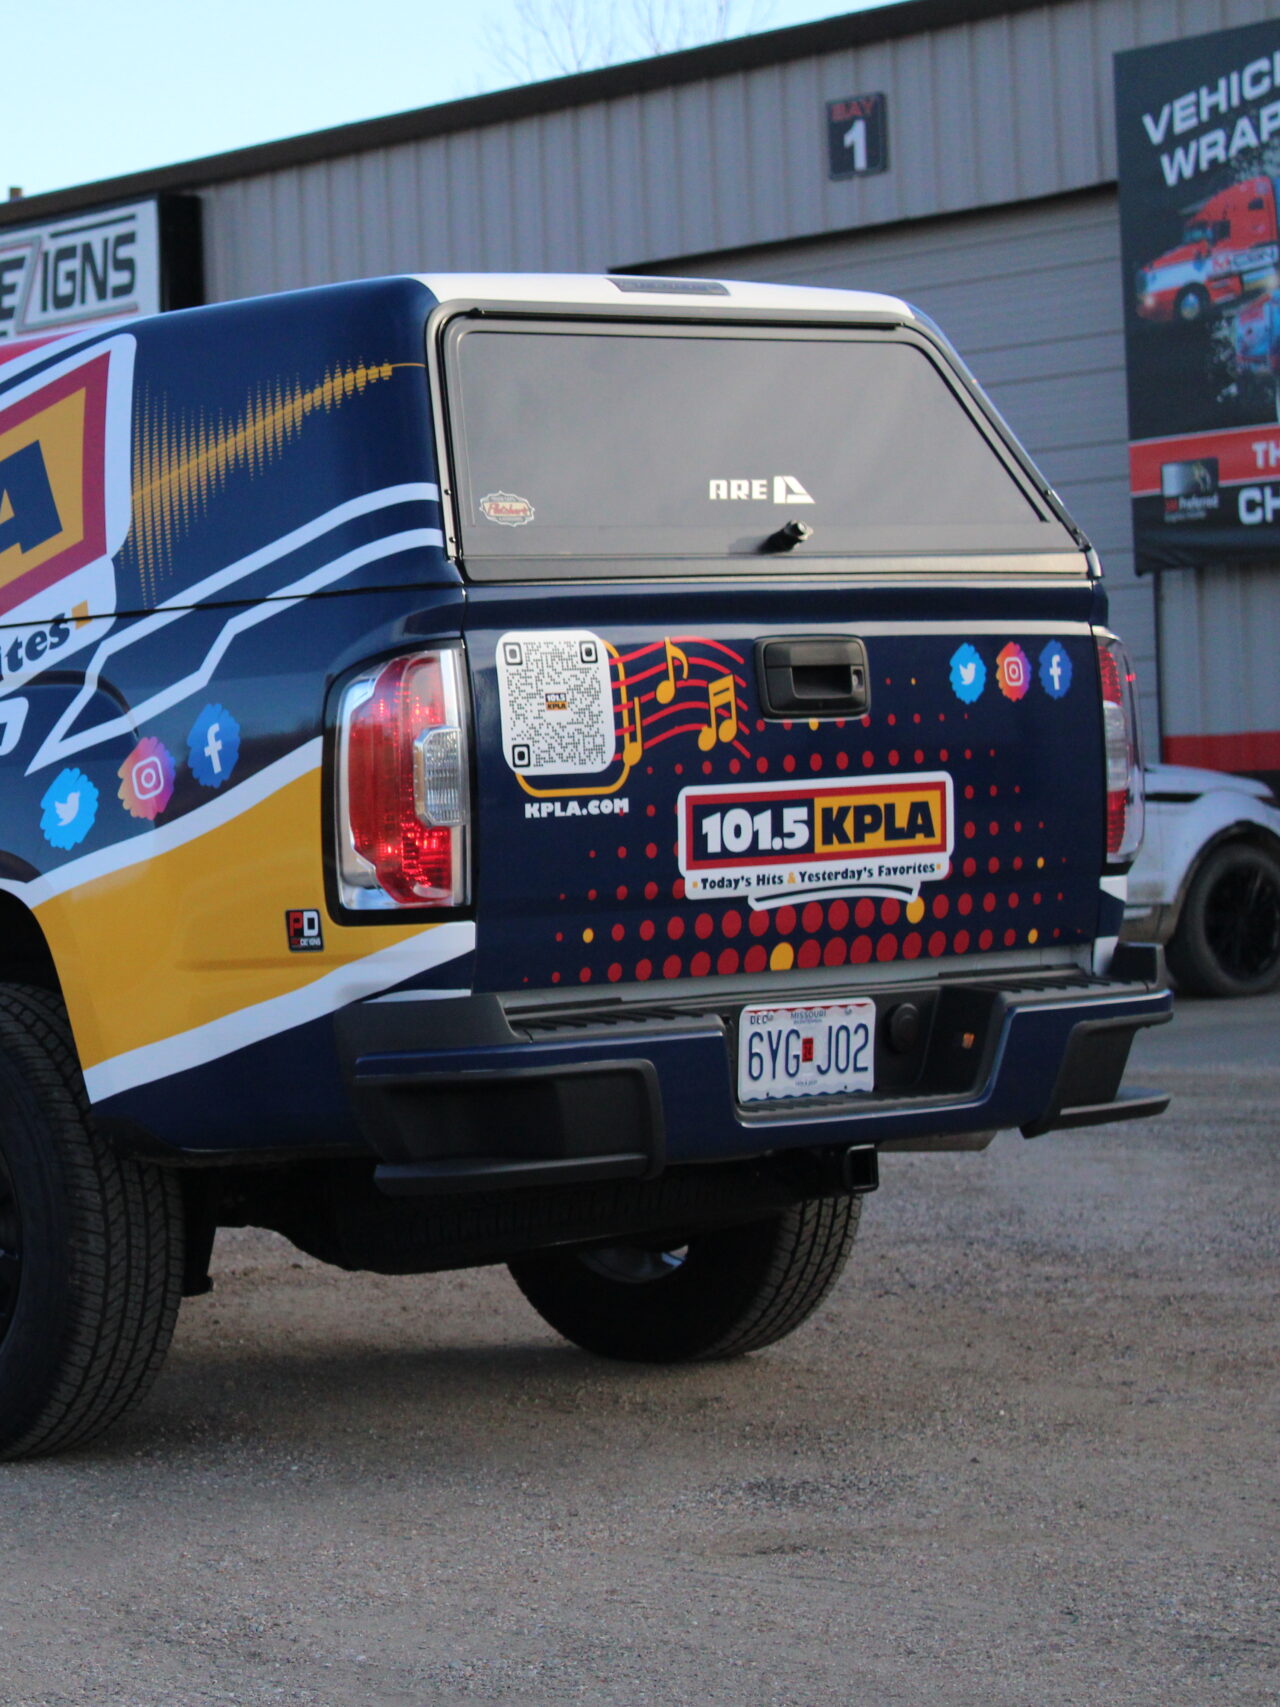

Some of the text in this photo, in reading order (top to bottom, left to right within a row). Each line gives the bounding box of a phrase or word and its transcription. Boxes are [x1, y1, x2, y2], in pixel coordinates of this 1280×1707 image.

[843, 118, 867, 171] 1
[524, 798, 630, 819] KPLA.COM
[701, 800, 936, 853] 101.5 KPLA
[700, 862, 935, 891] Today's Hits & Yesterday's Favorites
[289, 910, 319, 937] PD
[748, 1028, 801, 1081] 6YG
